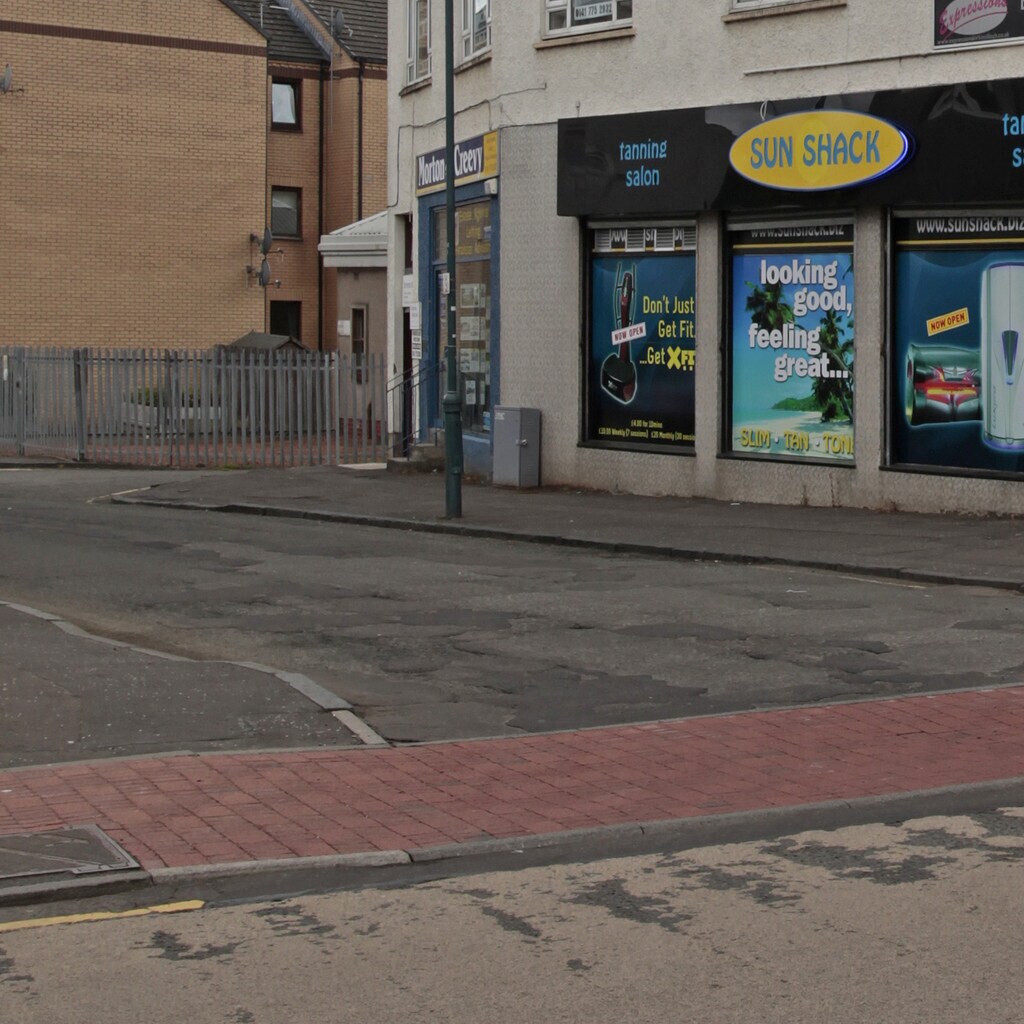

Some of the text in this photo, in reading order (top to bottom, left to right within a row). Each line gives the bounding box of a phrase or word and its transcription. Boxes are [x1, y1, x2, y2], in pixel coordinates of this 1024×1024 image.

[619, 137, 667, 160] tanning
[750, 130, 881, 169] SUN SHACK
[418, 155, 445, 186] Morton
[454, 144, 483, 180] Creevy
[626, 165, 660, 187] salon
[761, 259, 838, 290] looking
[642, 295, 695, 314] Don't Just
[793, 285, 852, 316] good,
[658, 320, 676, 338] Get
[931, 312, 965, 331] NOW OPEN
[614, 326, 644, 342] NOW OPEN
[748, 323, 821, 355] feeling
[774, 352, 849, 382] great...
[741, 427, 770, 448] SLIM
[784, 430, 810, 451] TAN
